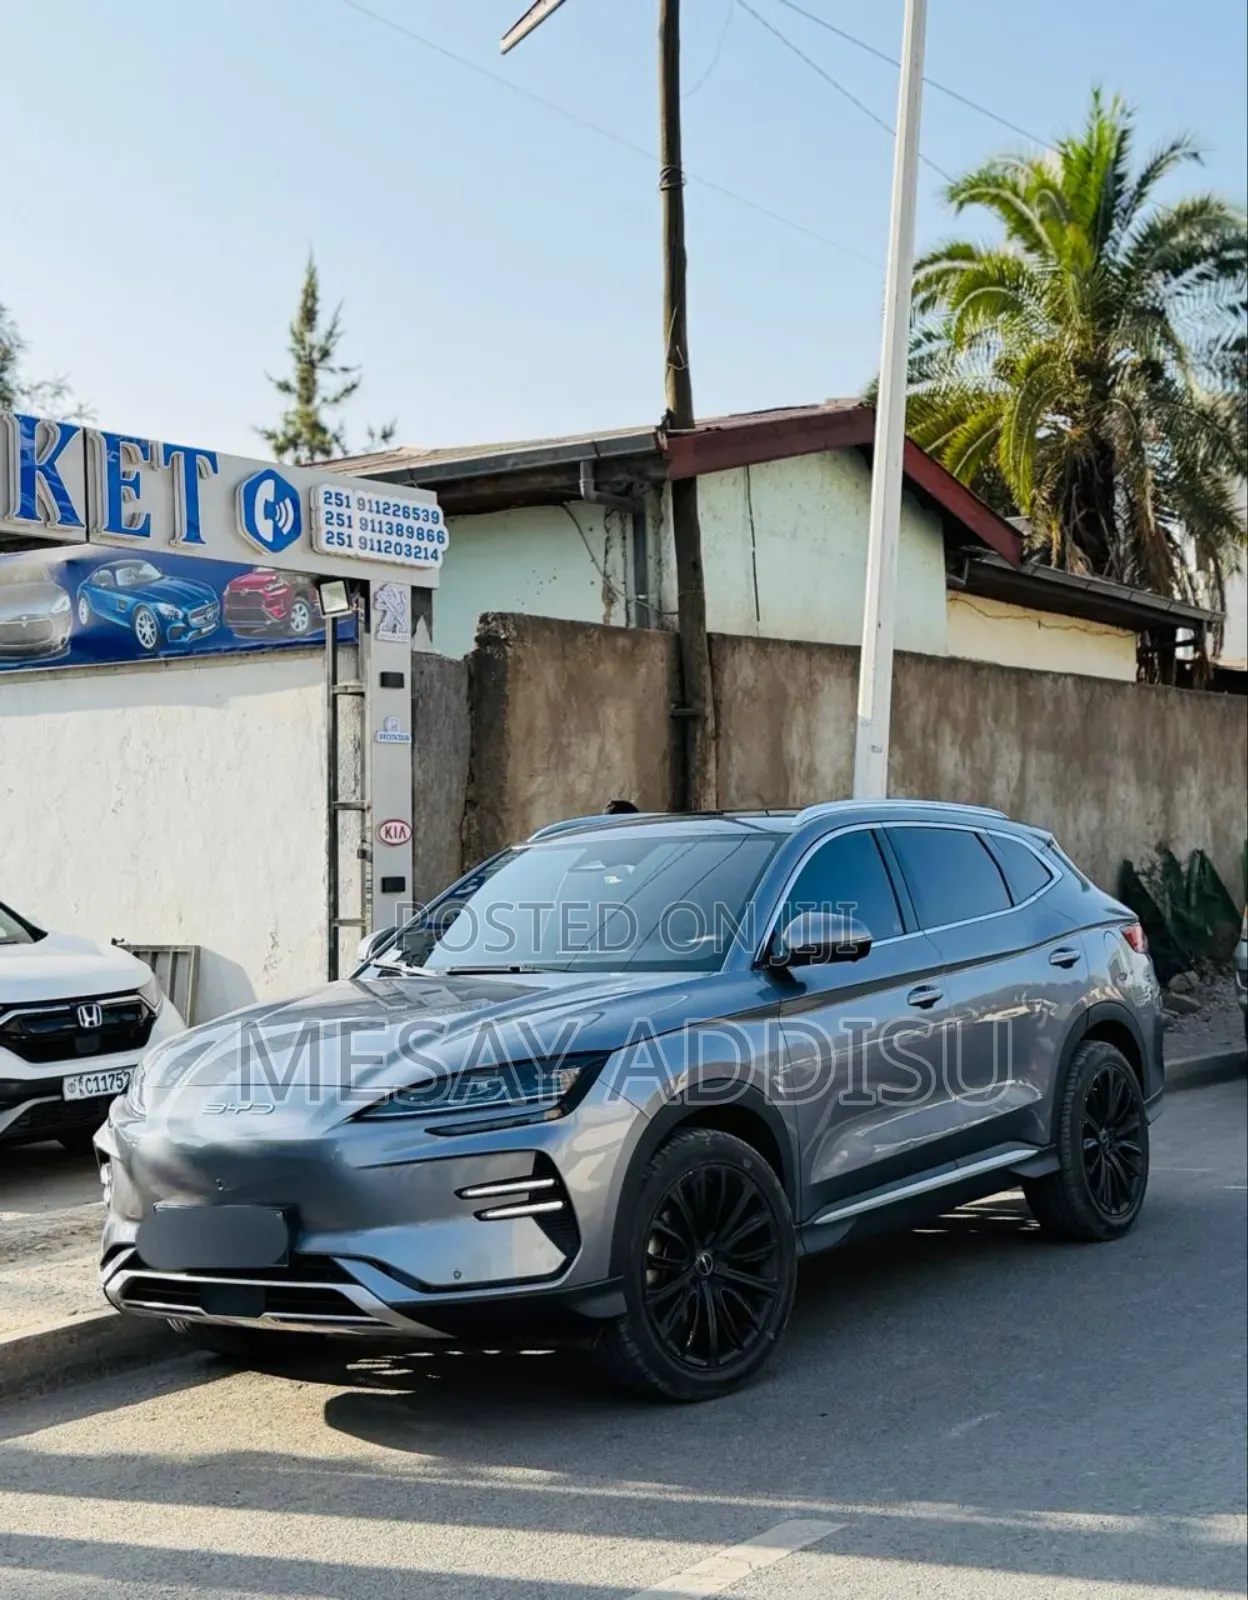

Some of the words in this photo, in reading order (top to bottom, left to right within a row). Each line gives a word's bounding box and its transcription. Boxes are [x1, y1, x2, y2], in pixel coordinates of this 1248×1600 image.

[4, 411, 219, 546] KET
[323, 490, 352, 509] 251
[357, 497, 440, 524] 911226539
[324, 510, 353, 529] 251
[359, 517, 446, 544] 911389866
[325, 531, 353, 548] 251
[358, 536, 439, 561] 911203214
[384, 825, 407, 840] KIA
